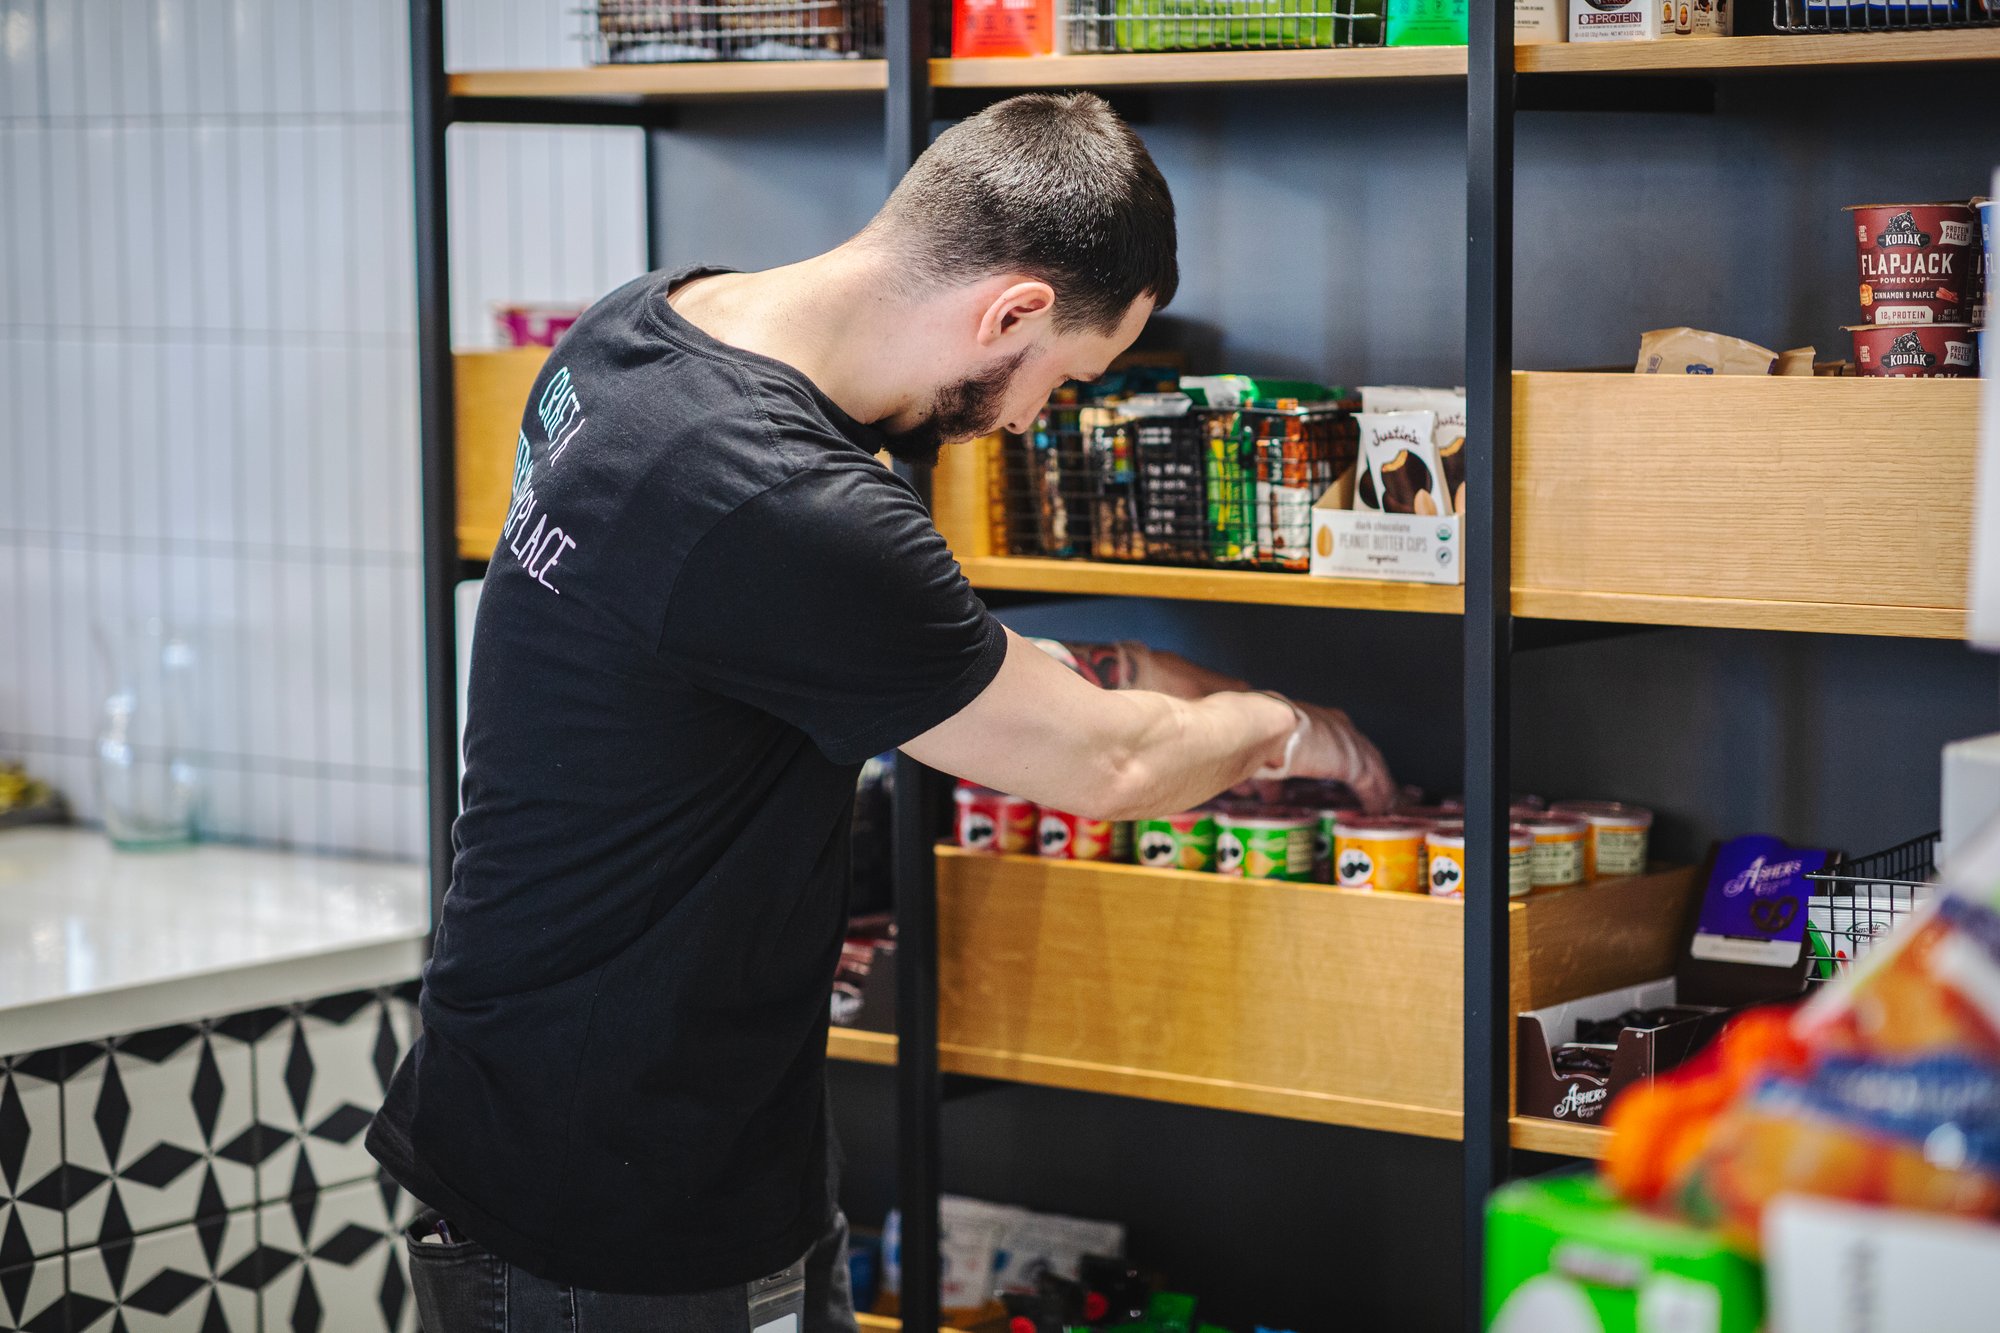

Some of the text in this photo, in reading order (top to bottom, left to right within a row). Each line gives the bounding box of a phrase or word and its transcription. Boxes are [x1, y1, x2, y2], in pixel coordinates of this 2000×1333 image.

[1595, 12, 1642, 24] PROTEIN
[1945, 225, 1970, 235] PROTEIN
[1884, 232, 1922, 247] KODIAK
[1861, 253, 1954, 275] FLAPJACK
[1874, 291, 1904, 299] CINNAMON
[1912, 291, 1934, 299] MAPLE
[1892, 311, 1926, 320] PROTEIN
[1889, 354, 1927, 367] KODIAK
[539, 366, 580, 451] CRAFT
[1372, 534, 1404, 551] BUTTER
